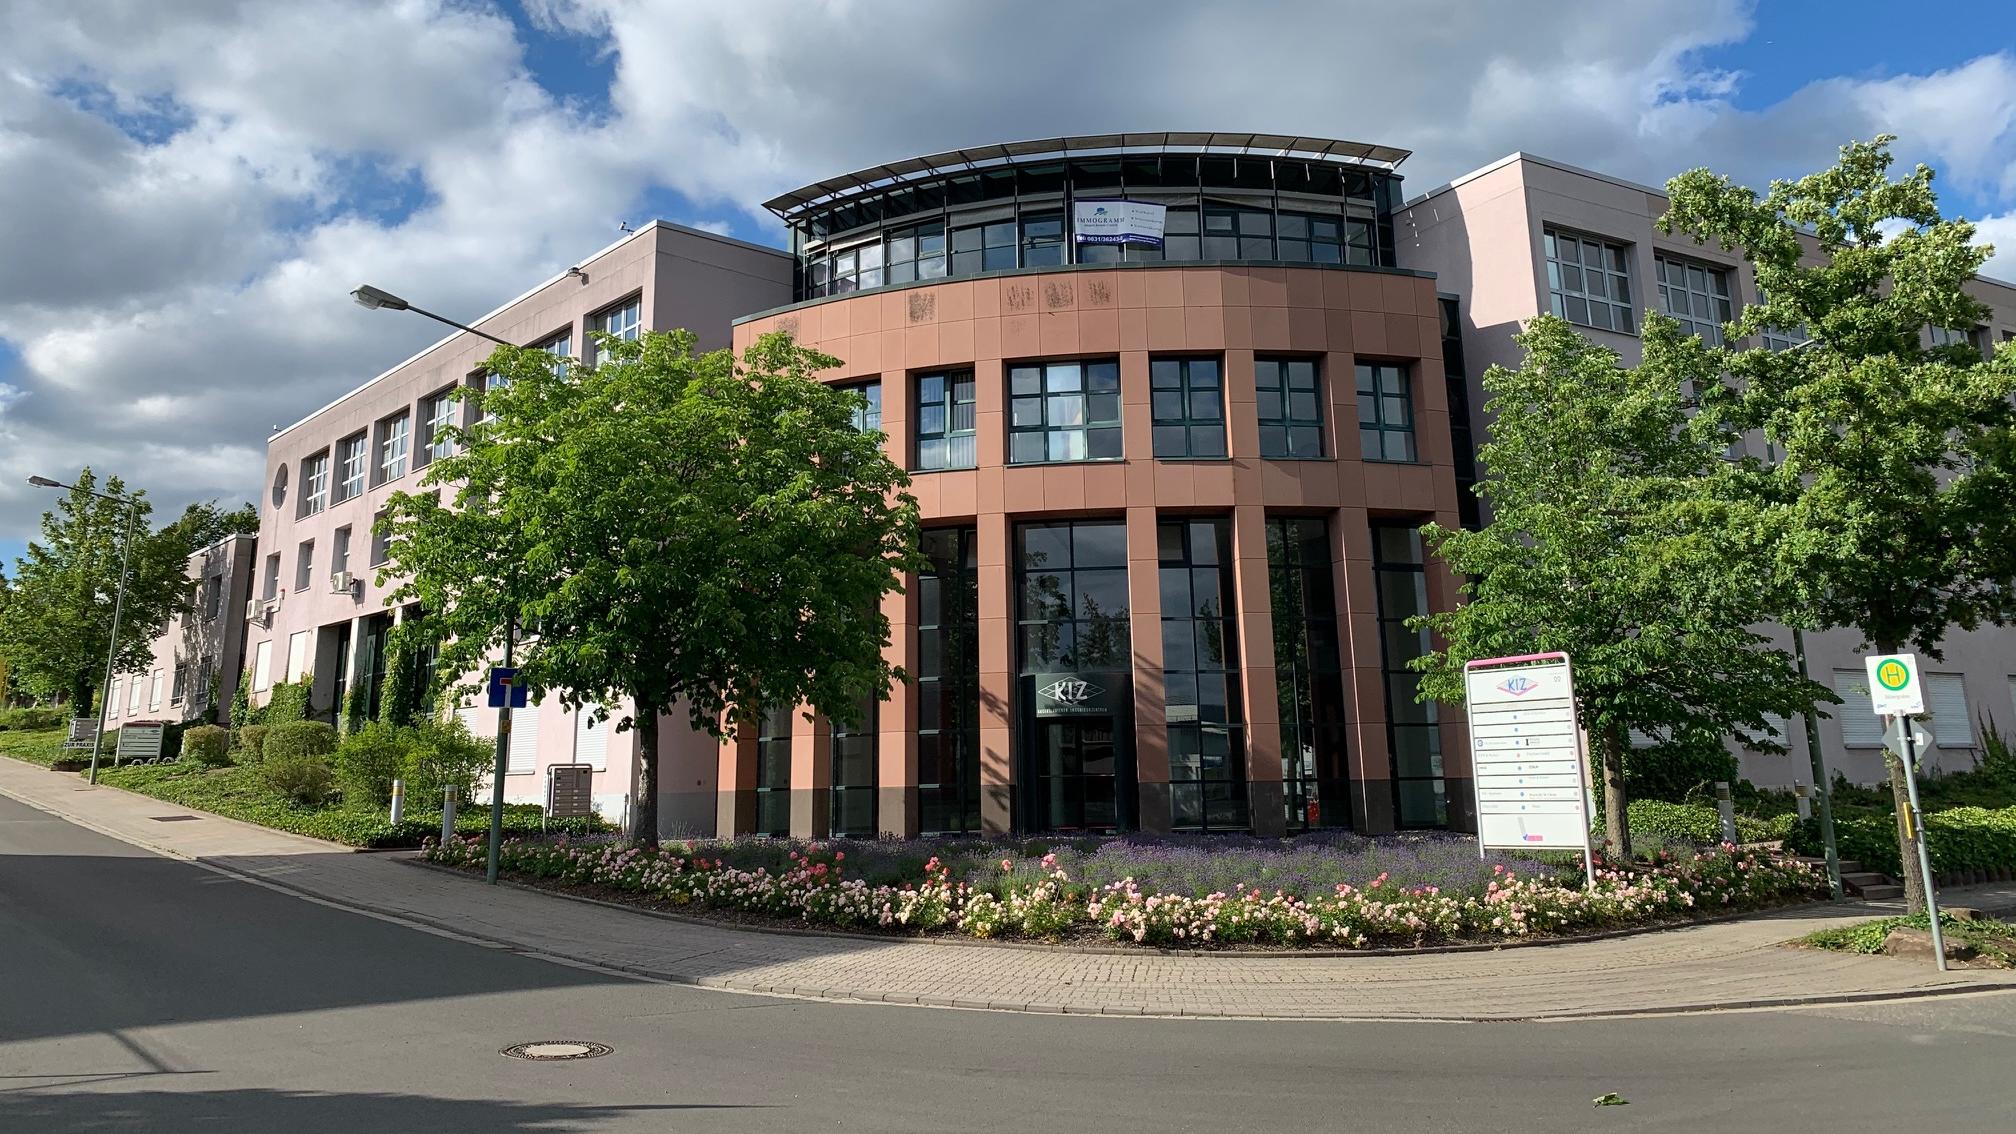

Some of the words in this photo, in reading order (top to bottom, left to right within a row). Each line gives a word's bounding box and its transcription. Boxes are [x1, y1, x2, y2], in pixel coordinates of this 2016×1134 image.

[1886, 666, 1901, 684] H
[1054, 681, 1088, 701] KIZ
[1507, 677, 1527, 692] KIZ
